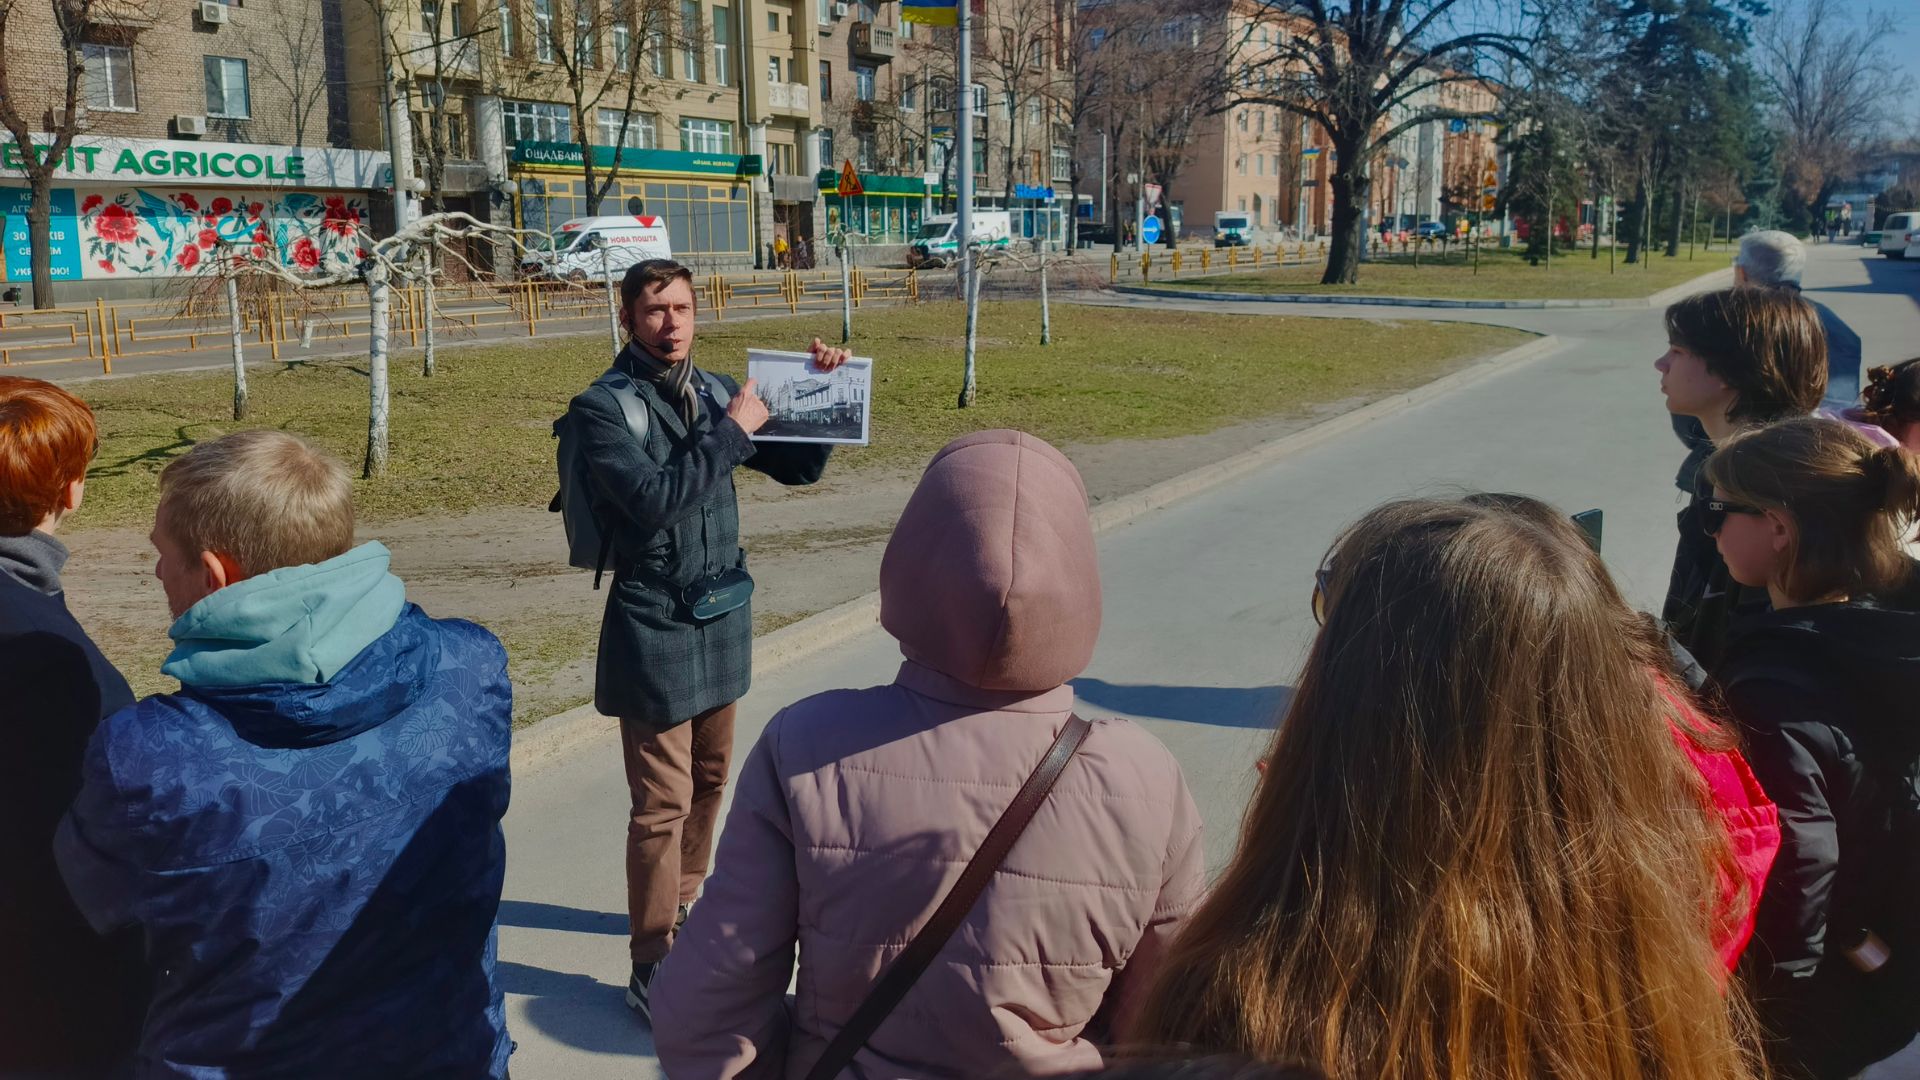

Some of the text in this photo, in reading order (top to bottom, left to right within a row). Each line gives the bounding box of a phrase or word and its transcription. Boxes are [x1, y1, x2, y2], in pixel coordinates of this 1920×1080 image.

[525, 148, 584, 161] ОЩАДБАНК
[112, 149, 306, 179] AGRICOLE
[610, 235, 658, 244] НОВА ПОШТА
